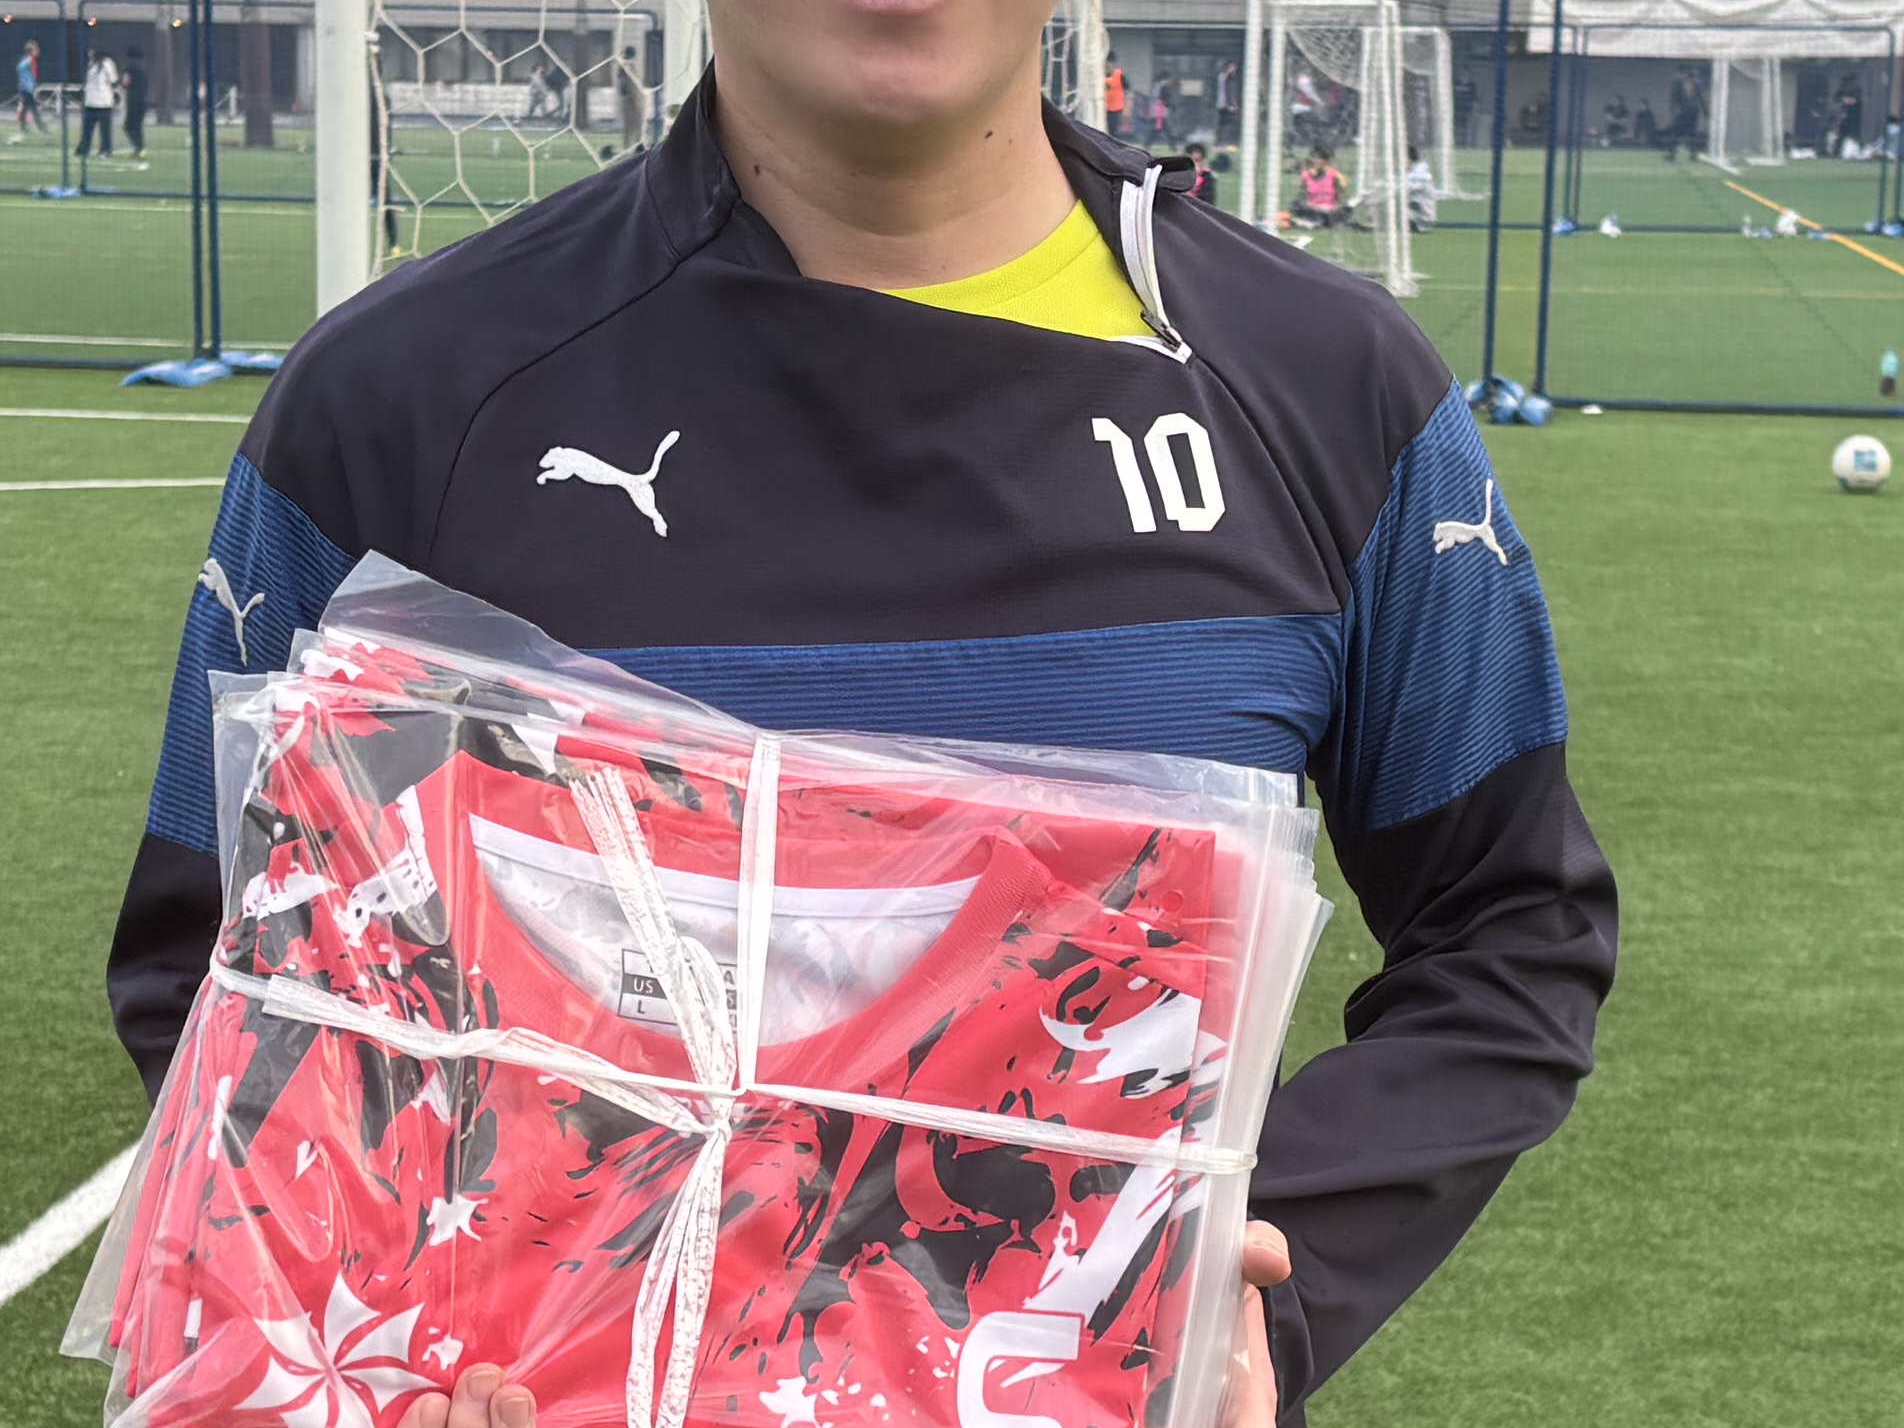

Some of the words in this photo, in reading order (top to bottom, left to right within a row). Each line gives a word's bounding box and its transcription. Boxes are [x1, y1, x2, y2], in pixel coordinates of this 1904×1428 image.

[1091, 410, 1226, 534] 10
[633, 976, 654, 994] US
[636, 999, 646, 1015] L
